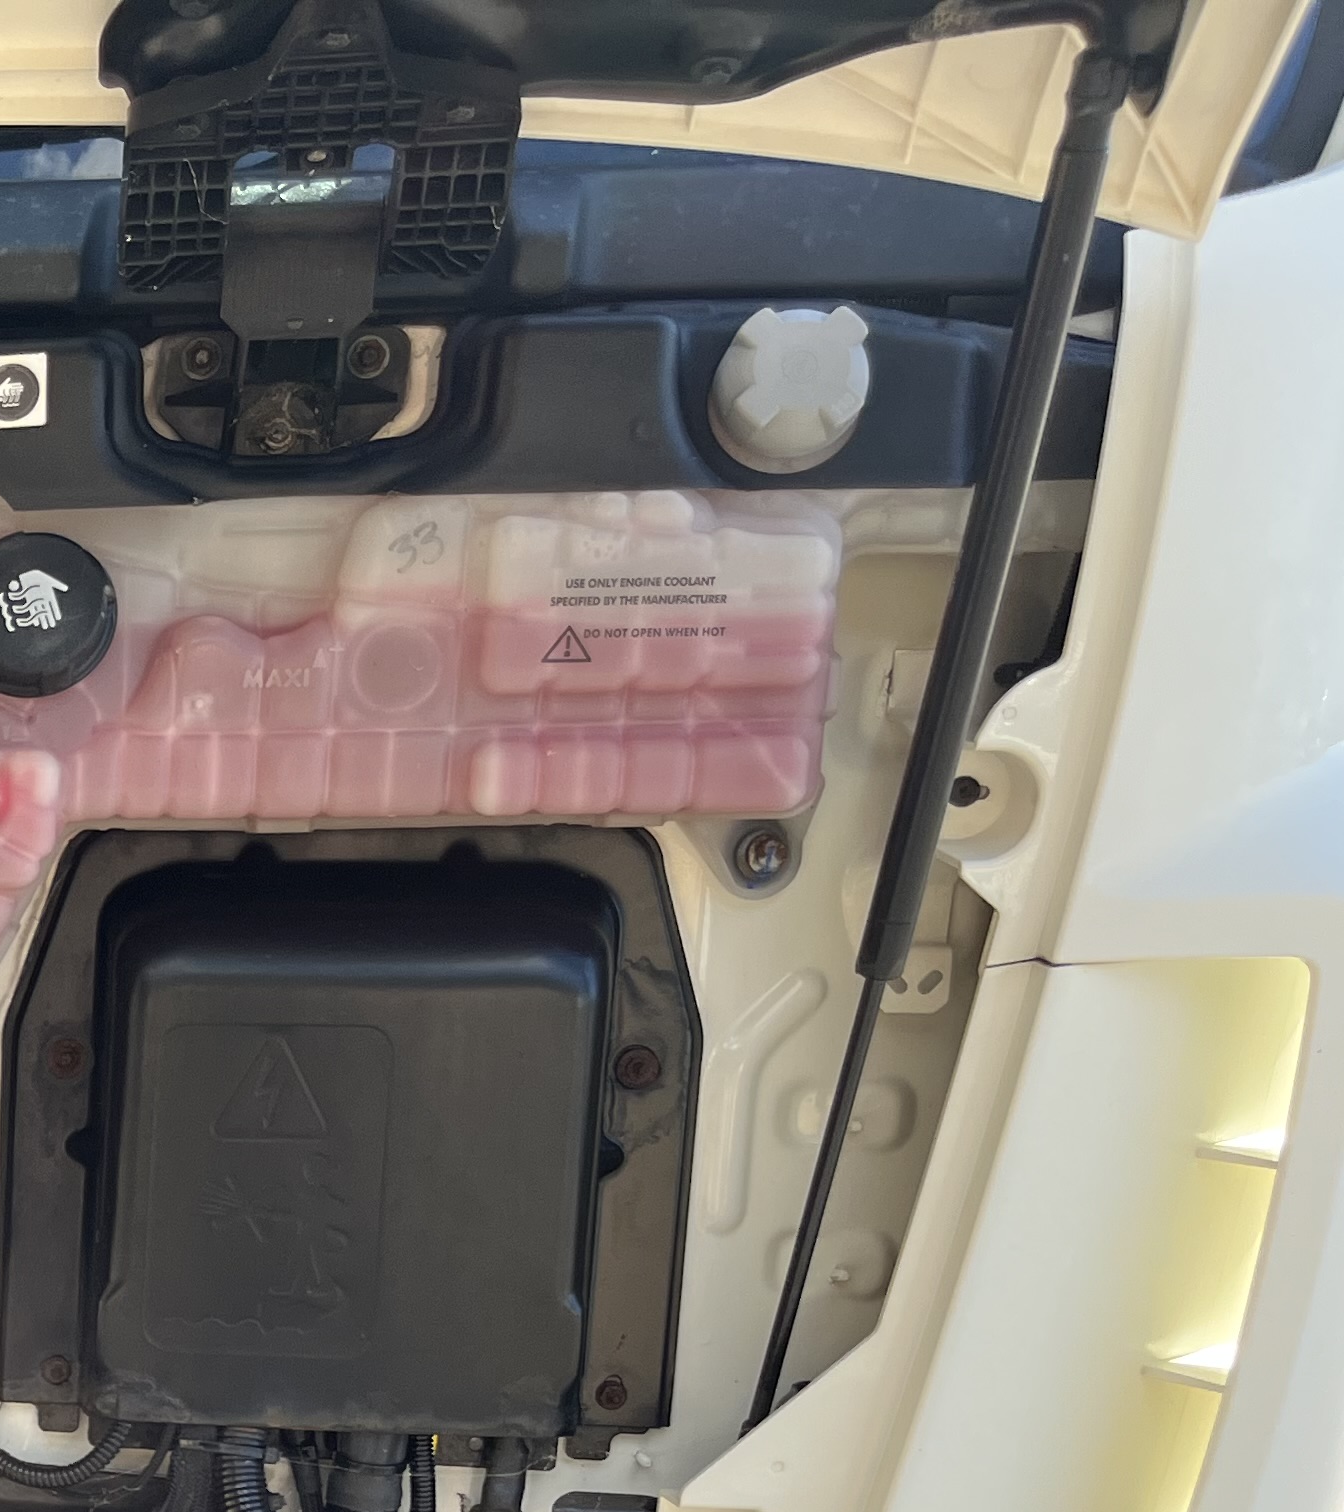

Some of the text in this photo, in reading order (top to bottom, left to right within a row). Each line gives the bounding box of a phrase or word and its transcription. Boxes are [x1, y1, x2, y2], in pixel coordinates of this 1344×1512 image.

[565, 576, 716, 589] USE ONLY ENGINE COOLANT
[550, 594, 727, 607] SPECIFIED BY THE MANUFACTURER
[583, 626, 726, 639] DO NOT OPEN WHEN HOT
[242, 667, 310, 689] MAXI
